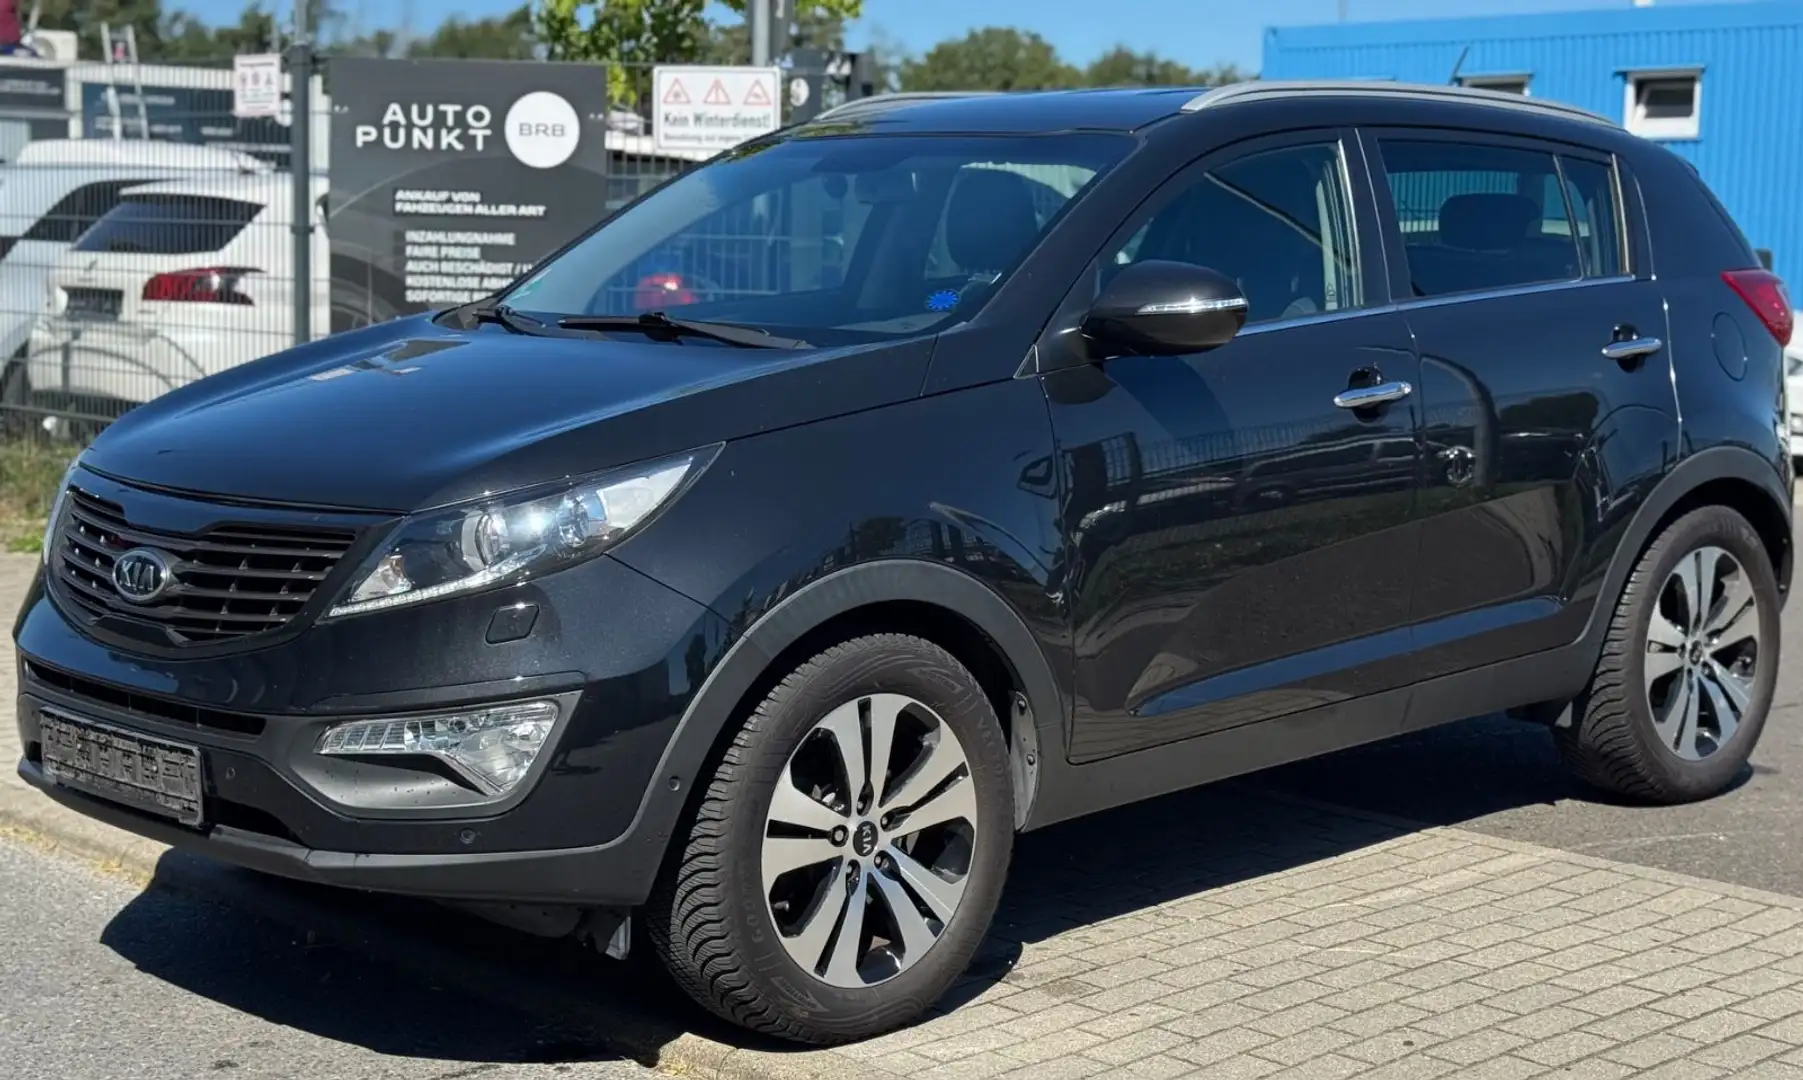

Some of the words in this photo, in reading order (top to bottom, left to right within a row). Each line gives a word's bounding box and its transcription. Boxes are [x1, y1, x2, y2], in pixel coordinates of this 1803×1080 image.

[382, 103, 492, 127] AUTO
[664, 112, 689, 126] Kein
[518, 122, 566, 137] BRB
[355, 125, 492, 151] PUNKT
[451, 191, 481, 202] VON
[474, 204, 517, 216] ALLER
[518, 205, 547, 216] ART
[405, 260, 439, 273] AUCH
